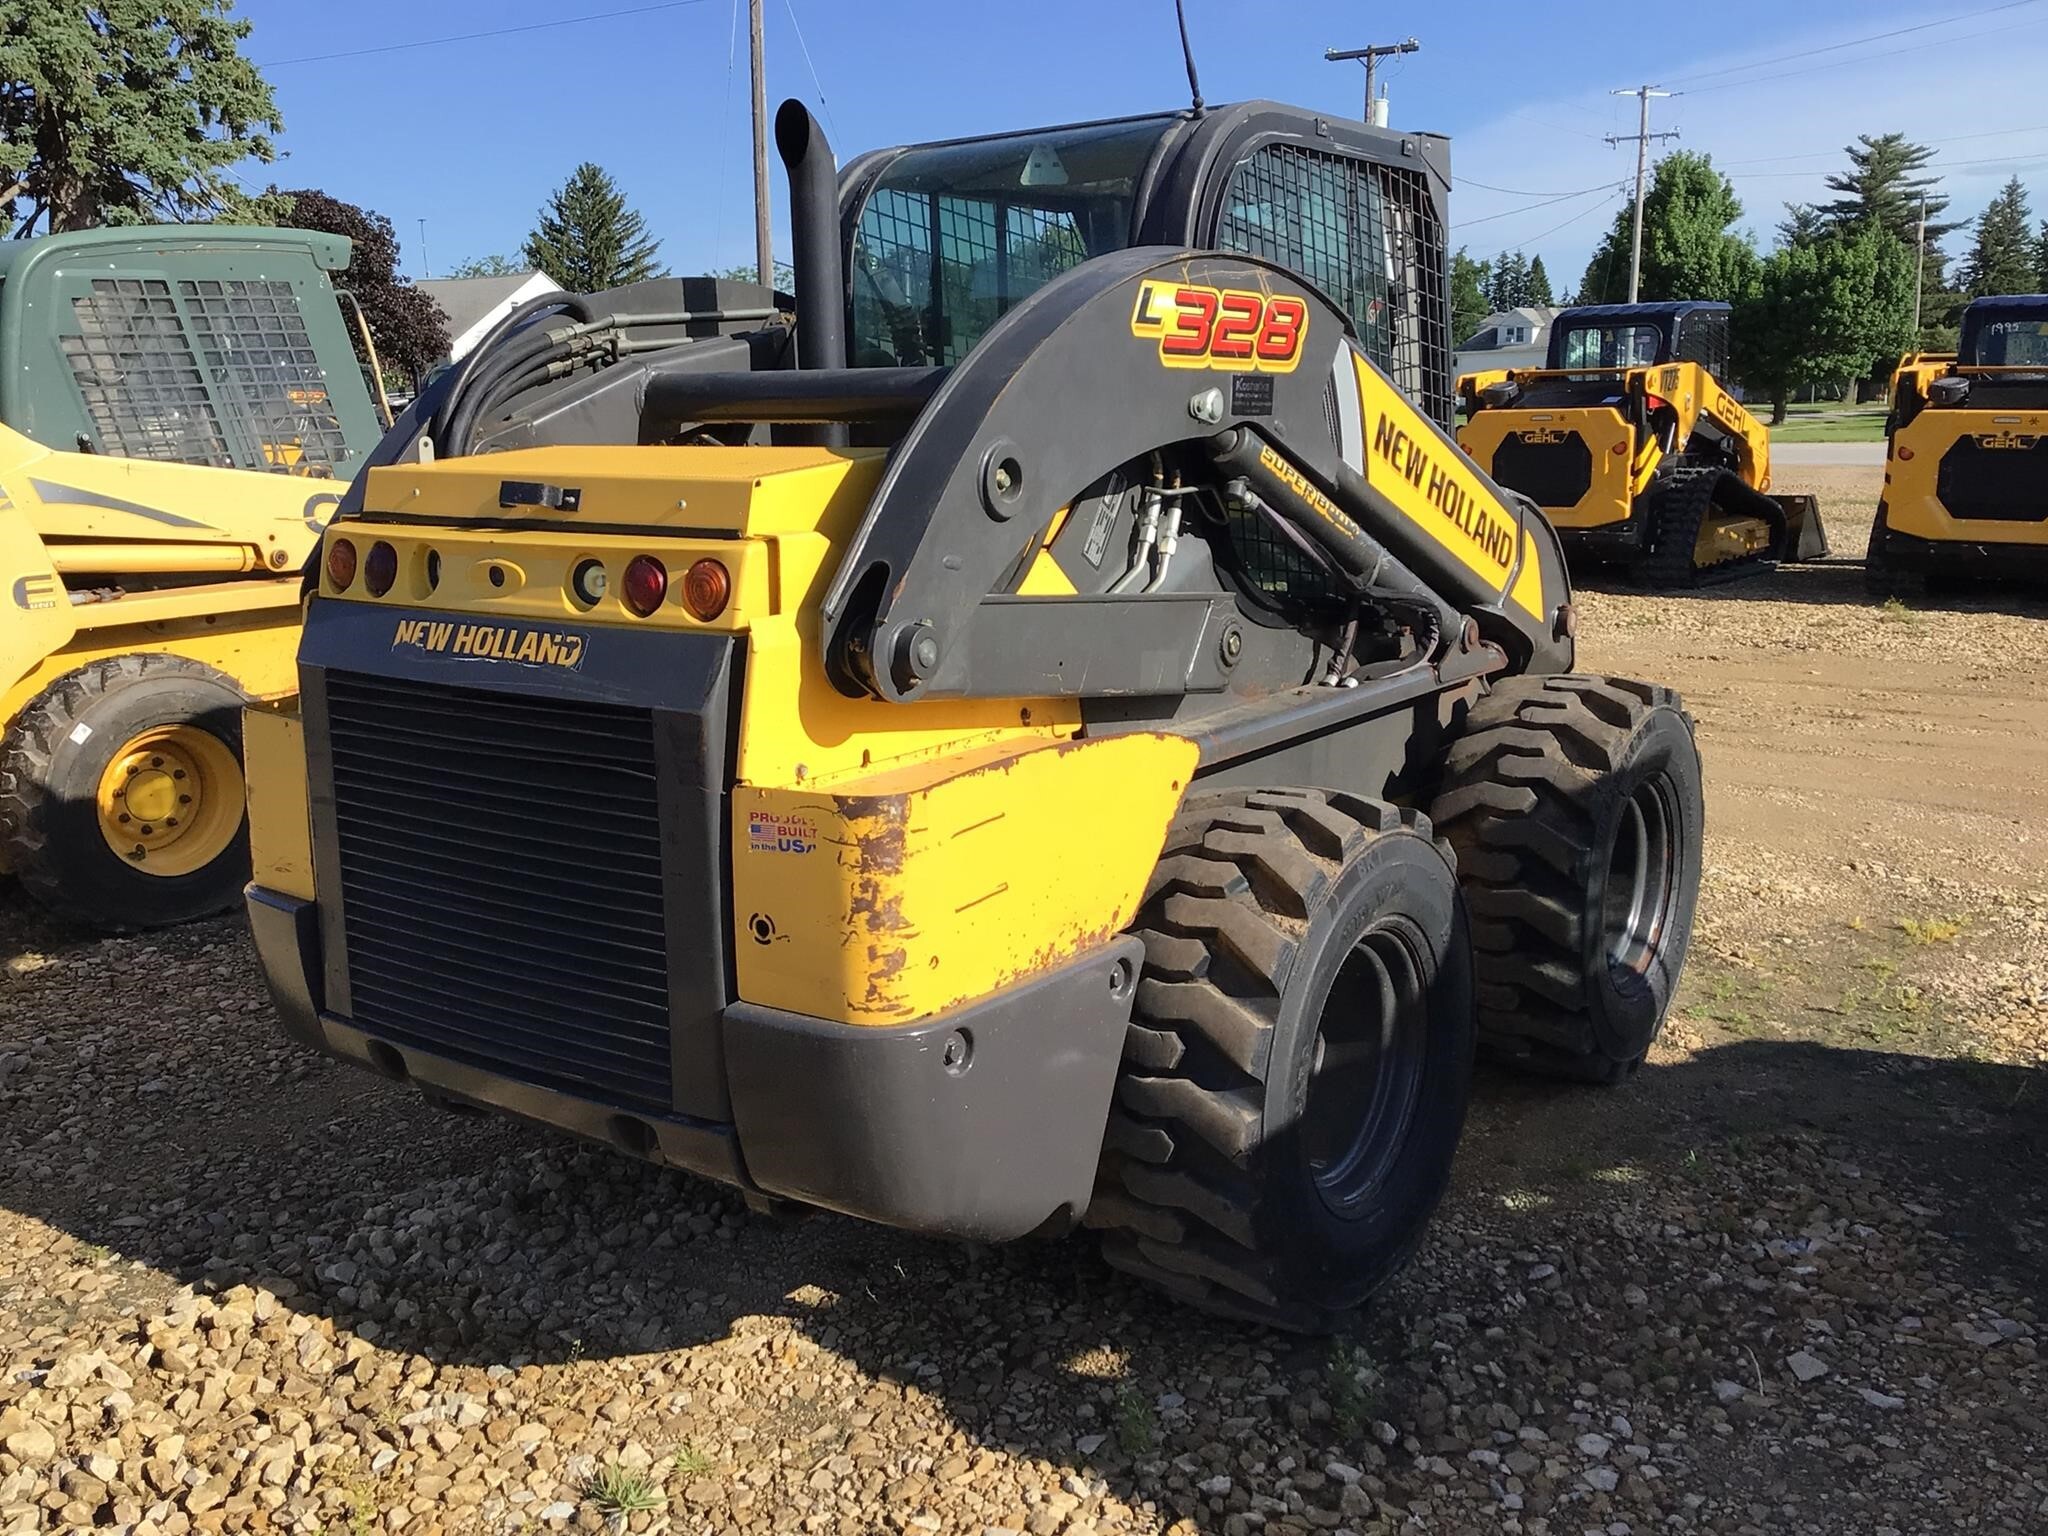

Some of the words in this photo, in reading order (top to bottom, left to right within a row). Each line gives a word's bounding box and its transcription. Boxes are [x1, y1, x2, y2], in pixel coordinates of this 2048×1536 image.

[1136, 286, 1304, 361] L328
[1716, 392, 1750, 438] GEHL
[1524, 433, 1560, 443] GEHL
[1982, 437, 2029, 449] GEHL
[1374, 412, 1428, 489] NEW
[1426, 462, 1513, 569] HOLLAND
[393, 620, 454, 652] NEW
[452, 625, 582, 668] HOLLAND
[750, 812, 815, 826] PRODL
[777, 826, 818, 839] BUILT
[751, 842, 760, 851] in
[761, 843, 777, 852] the
